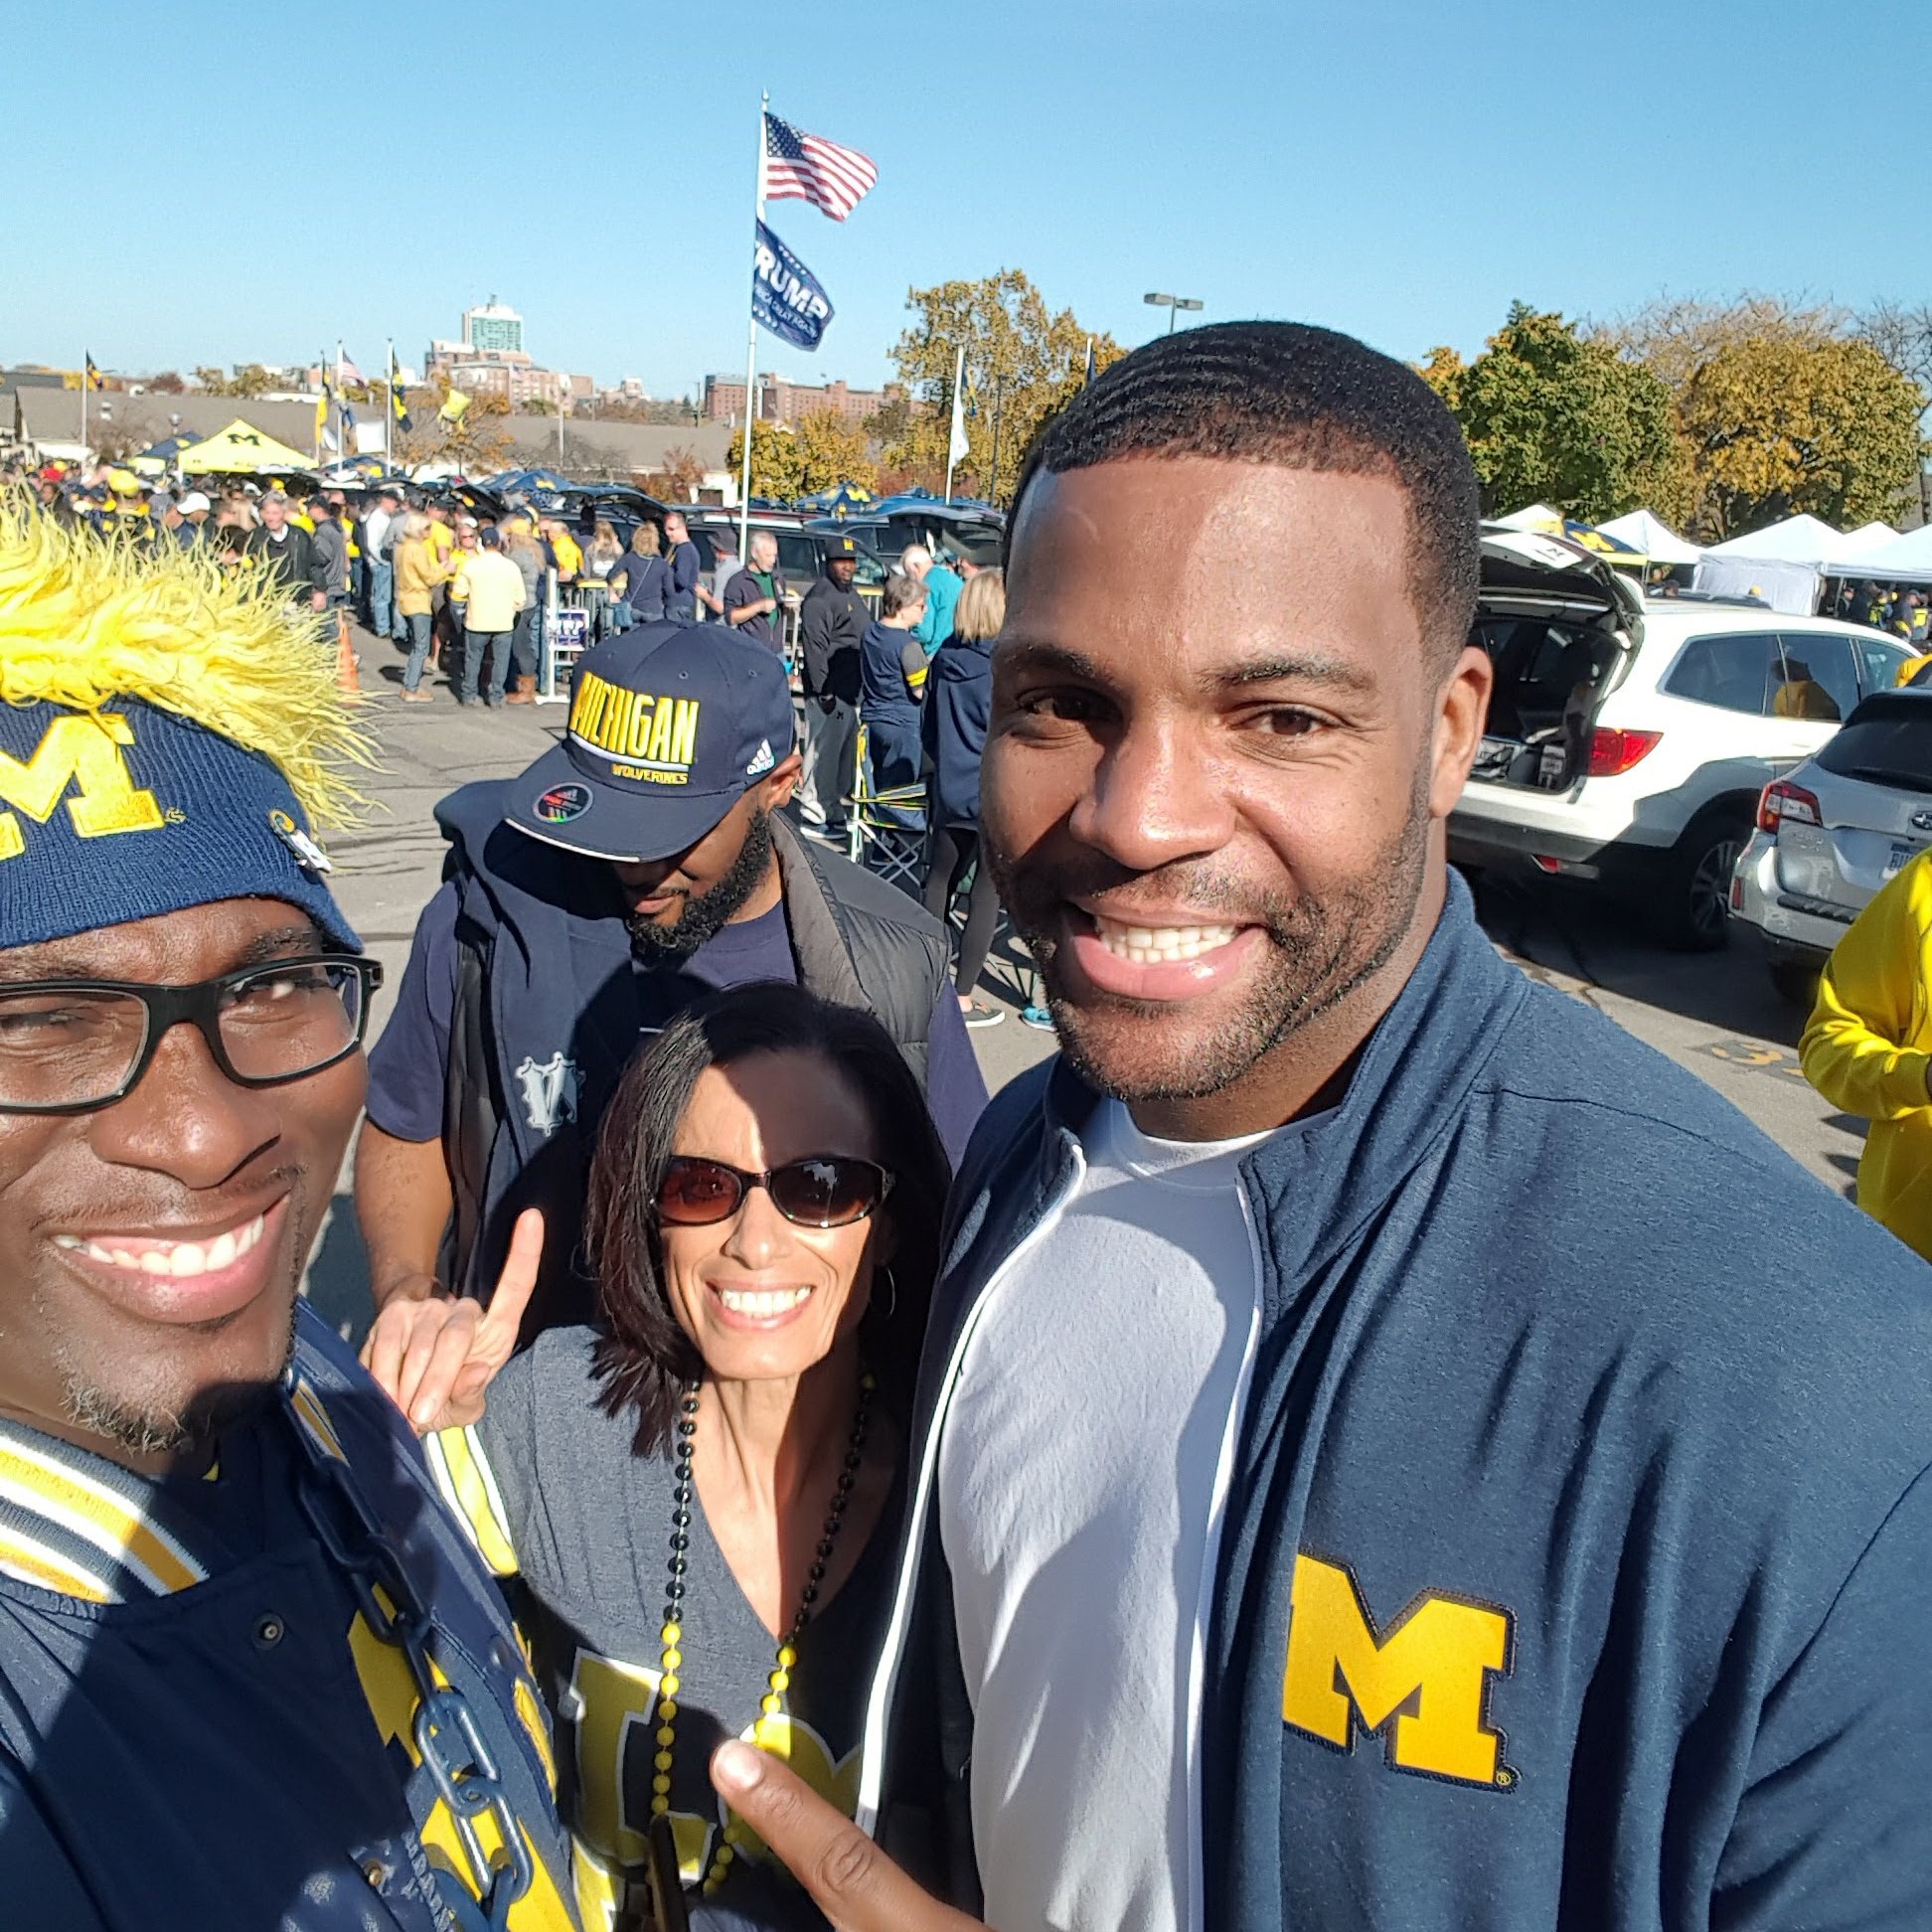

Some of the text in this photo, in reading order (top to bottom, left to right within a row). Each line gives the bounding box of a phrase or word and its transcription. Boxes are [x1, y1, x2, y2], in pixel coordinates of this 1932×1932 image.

[755, 241, 828, 319] RUMP
[569, 671, 700, 764] MICHIGAN
[0, 714, 165, 860] M
[611, 763, 689, 785] WOLVERINES
[1282, 1552, 1507, 1784] M
